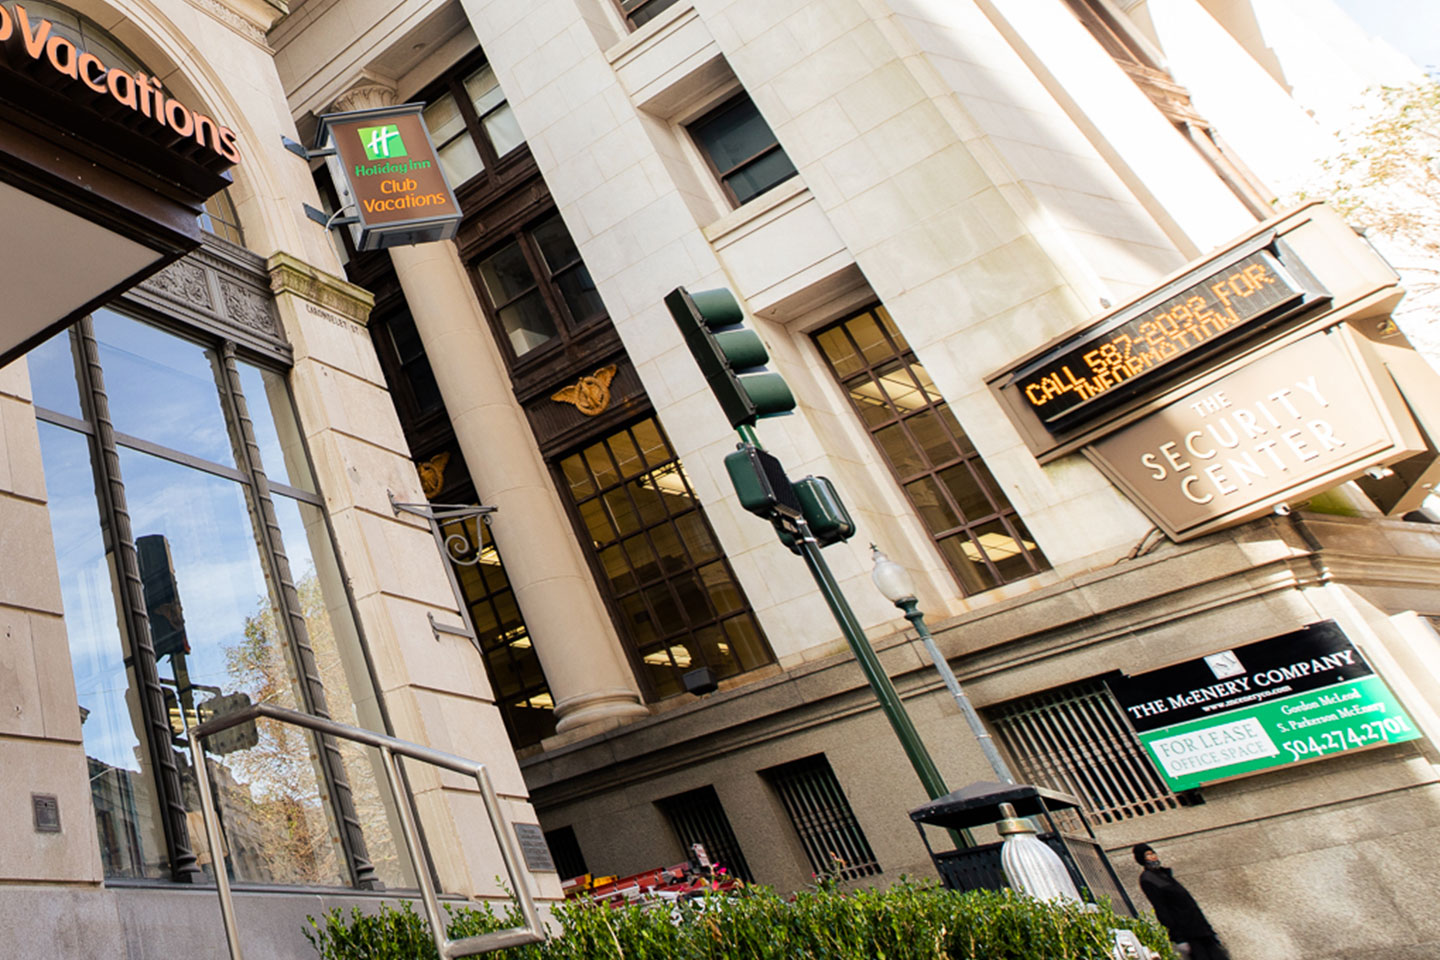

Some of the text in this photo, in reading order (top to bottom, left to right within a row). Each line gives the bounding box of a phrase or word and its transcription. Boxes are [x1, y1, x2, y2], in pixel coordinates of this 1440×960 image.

[15, 4, 242, 165] Vacations
[355, 158, 432, 177] Holiday Inn
[363, 192, 446, 213] Vacations
[380, 177, 418, 194] Club
[1025, 263, 1276, 407] CALL 587-2092 FOR
[1189, 390, 1233, 419] THE
[1140, 375, 1332, 482] SECURITY
[1180, 419, 1347, 506] CENTER
[1127, 650, 1356, 720] THE McENERY COMPANY
[1280, 687, 1363, 716] Gordon McLeod
[1276, 701, 1387, 733] S. Parkerson McEnery
[1159, 722, 1259, 758] FOR LEASE
[1281, 714, 1412, 762] 504.274.2701
[1169, 740, 1268, 772] OFFICE SPACE
